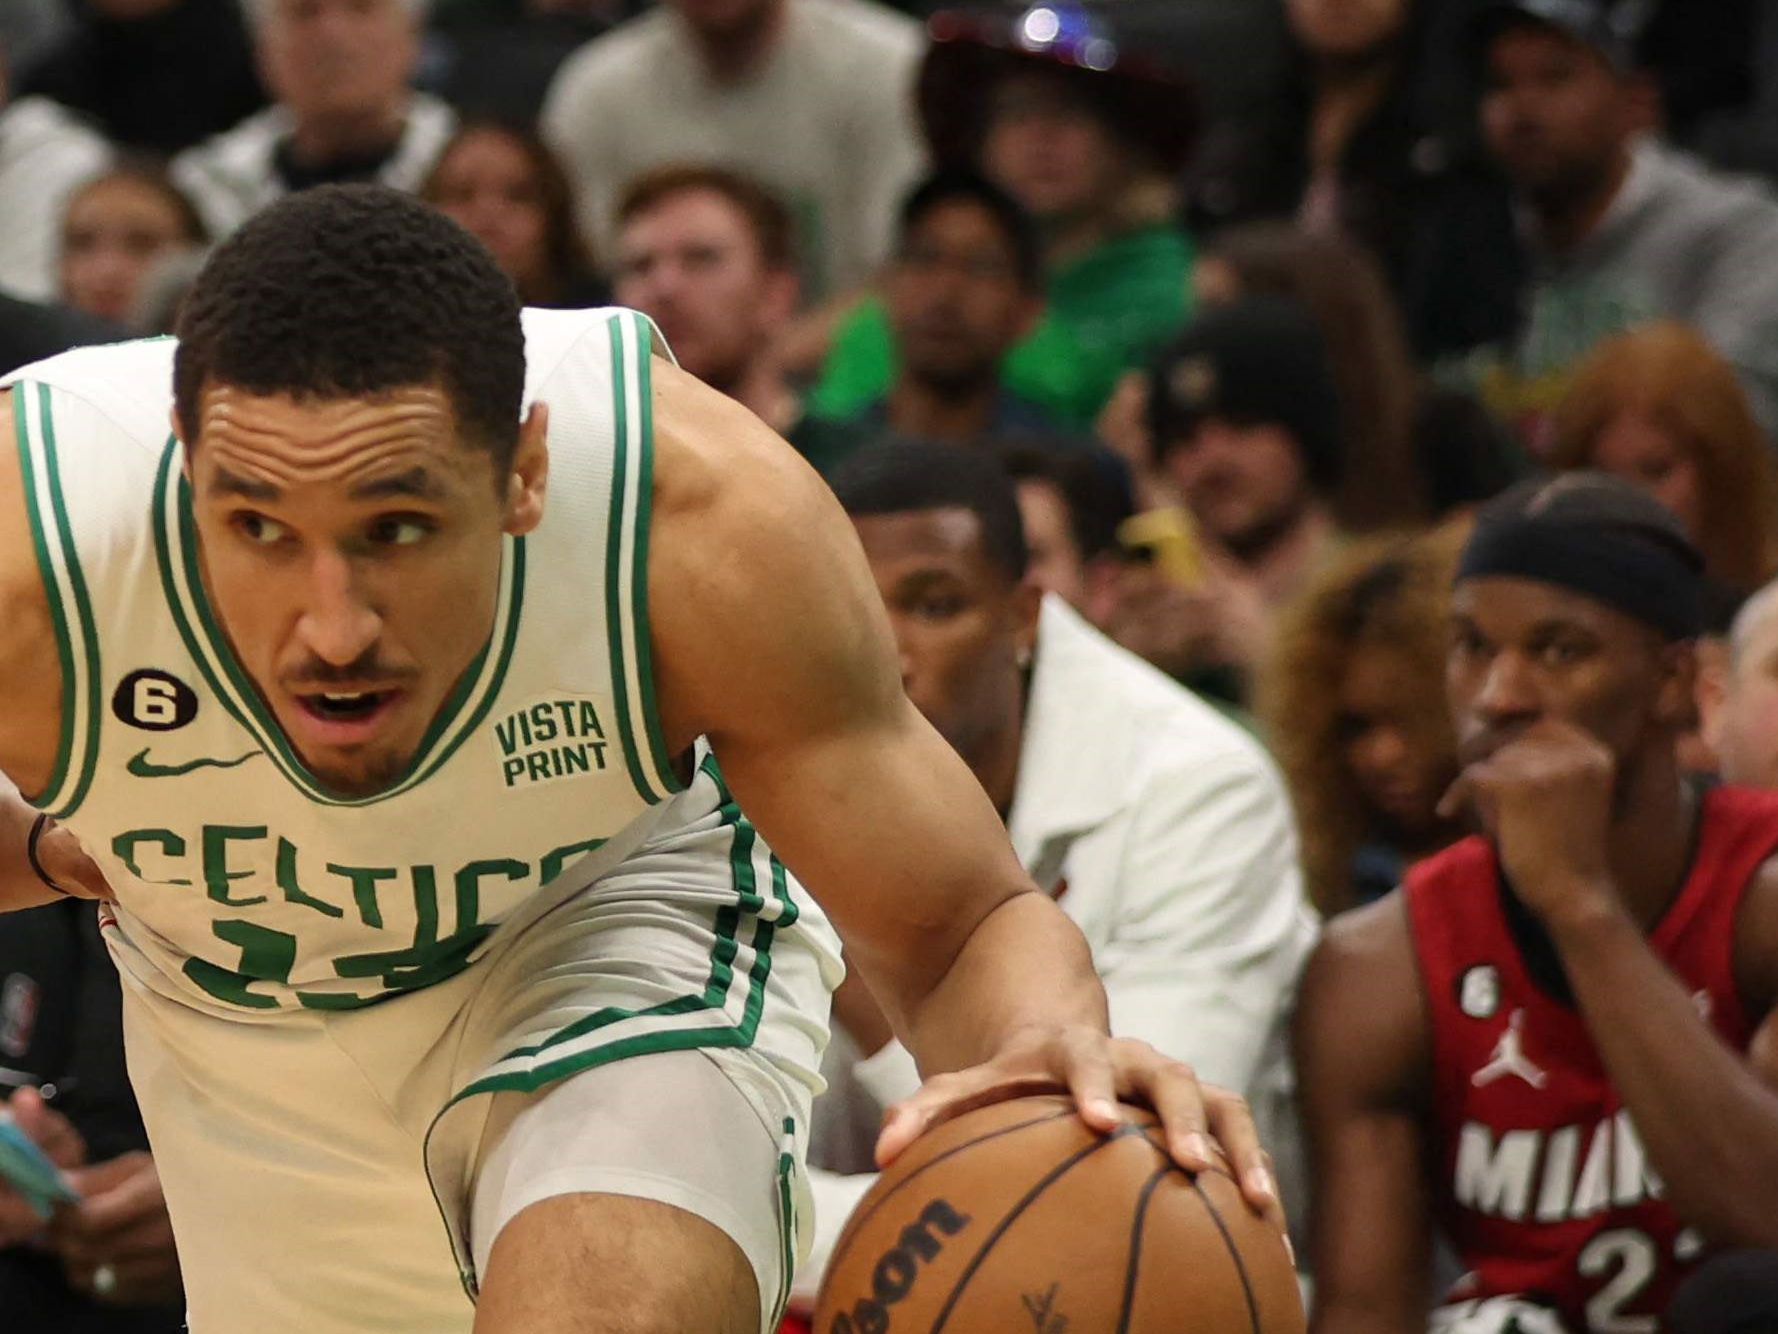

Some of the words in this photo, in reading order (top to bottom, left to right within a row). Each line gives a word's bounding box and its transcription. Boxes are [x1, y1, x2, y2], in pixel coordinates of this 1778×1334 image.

[132, 677, 177, 725] 6
[494, 700, 606, 756] VISTA
[503, 741, 608, 788] PRINT
[1453, 1107, 1667, 1223] MIA
